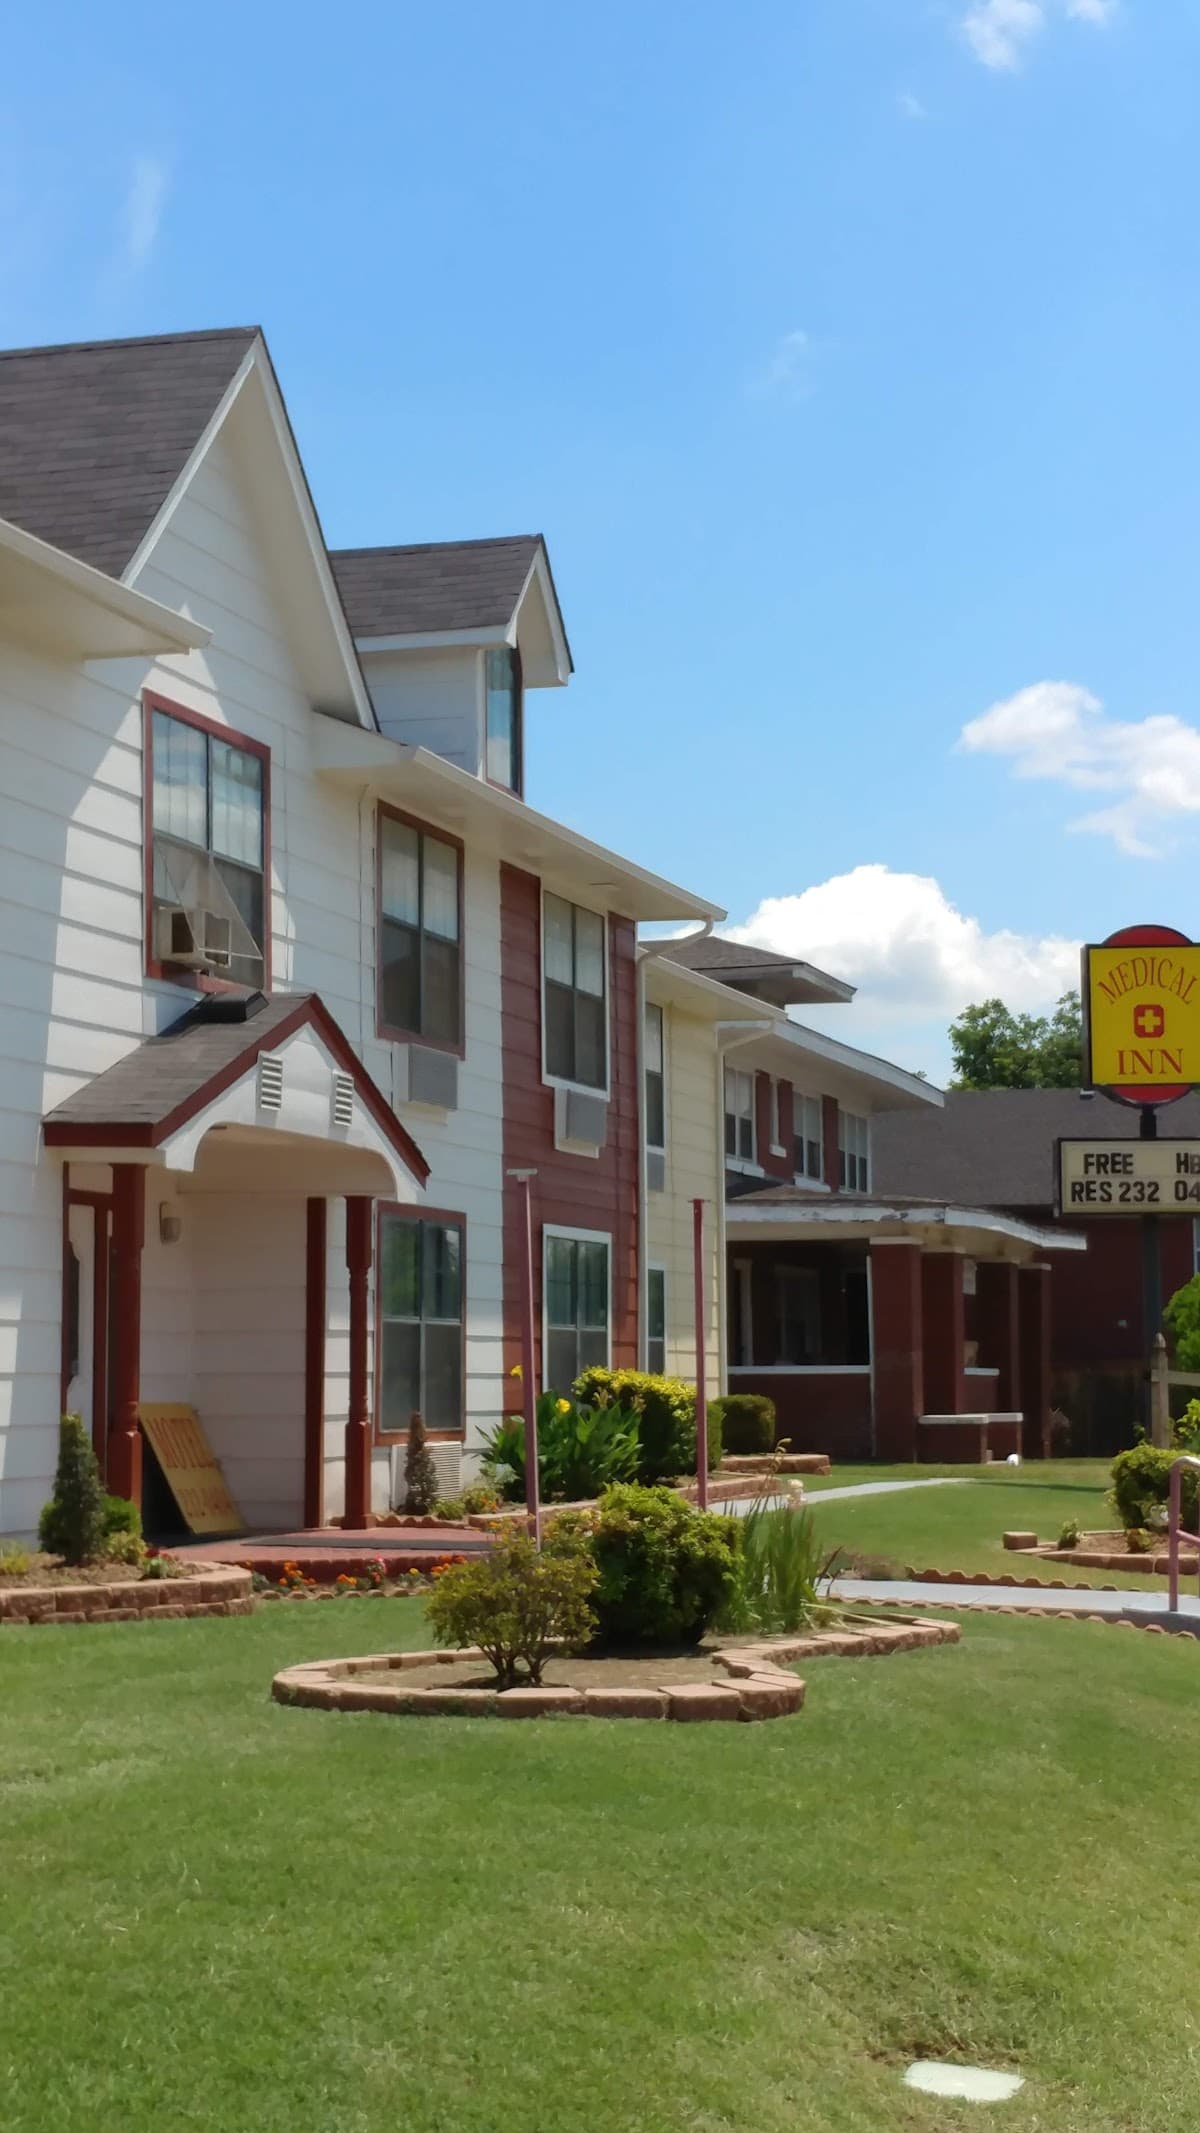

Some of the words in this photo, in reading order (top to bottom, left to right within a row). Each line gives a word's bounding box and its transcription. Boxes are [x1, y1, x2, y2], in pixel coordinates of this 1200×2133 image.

[1097, 956, 1198, 1005] MEDICAL
[1117, 1048, 1184, 1075] INN
[1083, 1152, 1134, 1175] FREE
[1071, 1181, 1113, 1202] RES
[1118, 1181, 1160, 1202] 232
